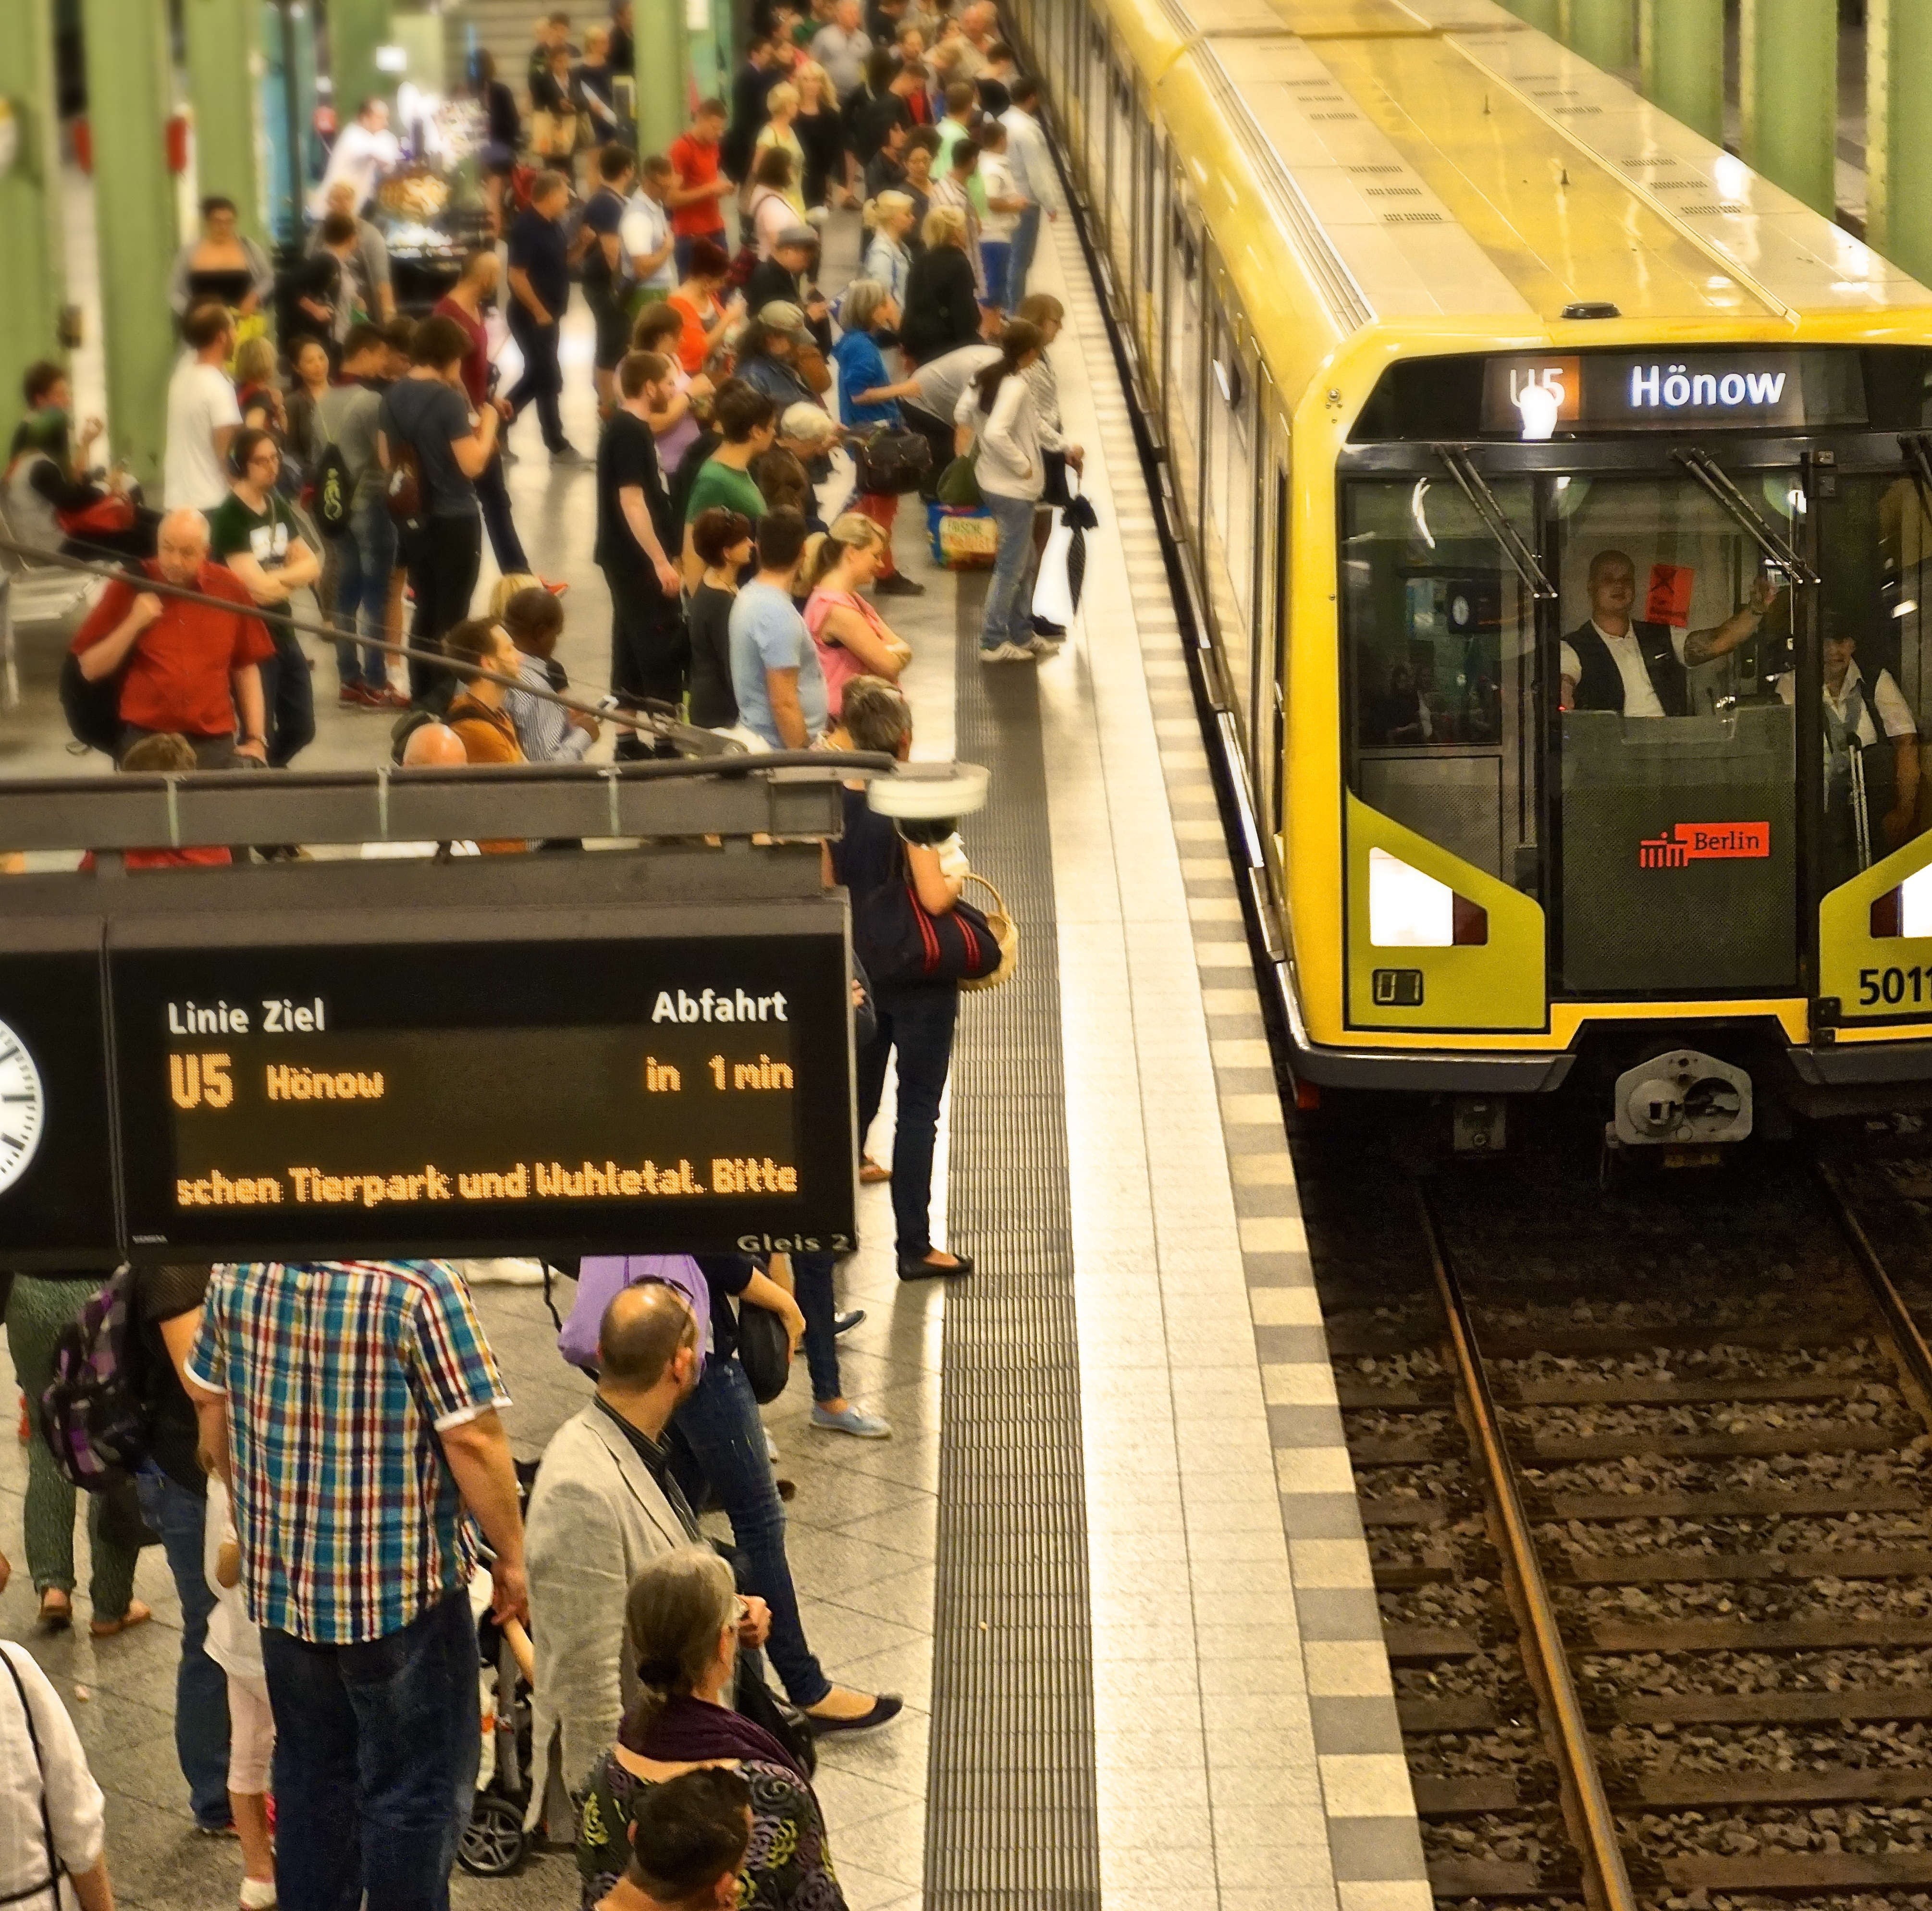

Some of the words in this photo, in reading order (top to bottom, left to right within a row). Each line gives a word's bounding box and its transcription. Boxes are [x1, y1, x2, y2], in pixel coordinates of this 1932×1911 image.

[1510, 368, 1564, 408] U5
[1633, 365, 1786, 407] Hönow
[1694, 831, 1760, 850] Berlin
[168, 1000, 250, 1034] Linie
[262, 997, 325, 1032] Ziel
[651, 988, 788, 1023] Abfahrt
[170, 1053, 234, 1109] U5
[266, 1065, 384, 1100] Hönow
[646, 1056, 681, 1091] in
[708, 1054, 726, 1090] 1
[734, 1054, 794, 1090] min
[177, 1170, 283, 1205] schen
[288, 1164, 453, 1207] Tierpark
[458, 1162, 529, 1199] und
[535, 1159, 707, 1198] Wuhletal.
[712, 1158, 798, 1193] Bitte
[737, 1233, 822, 1253] Gleis
[831, 1233, 850, 1251] 2
